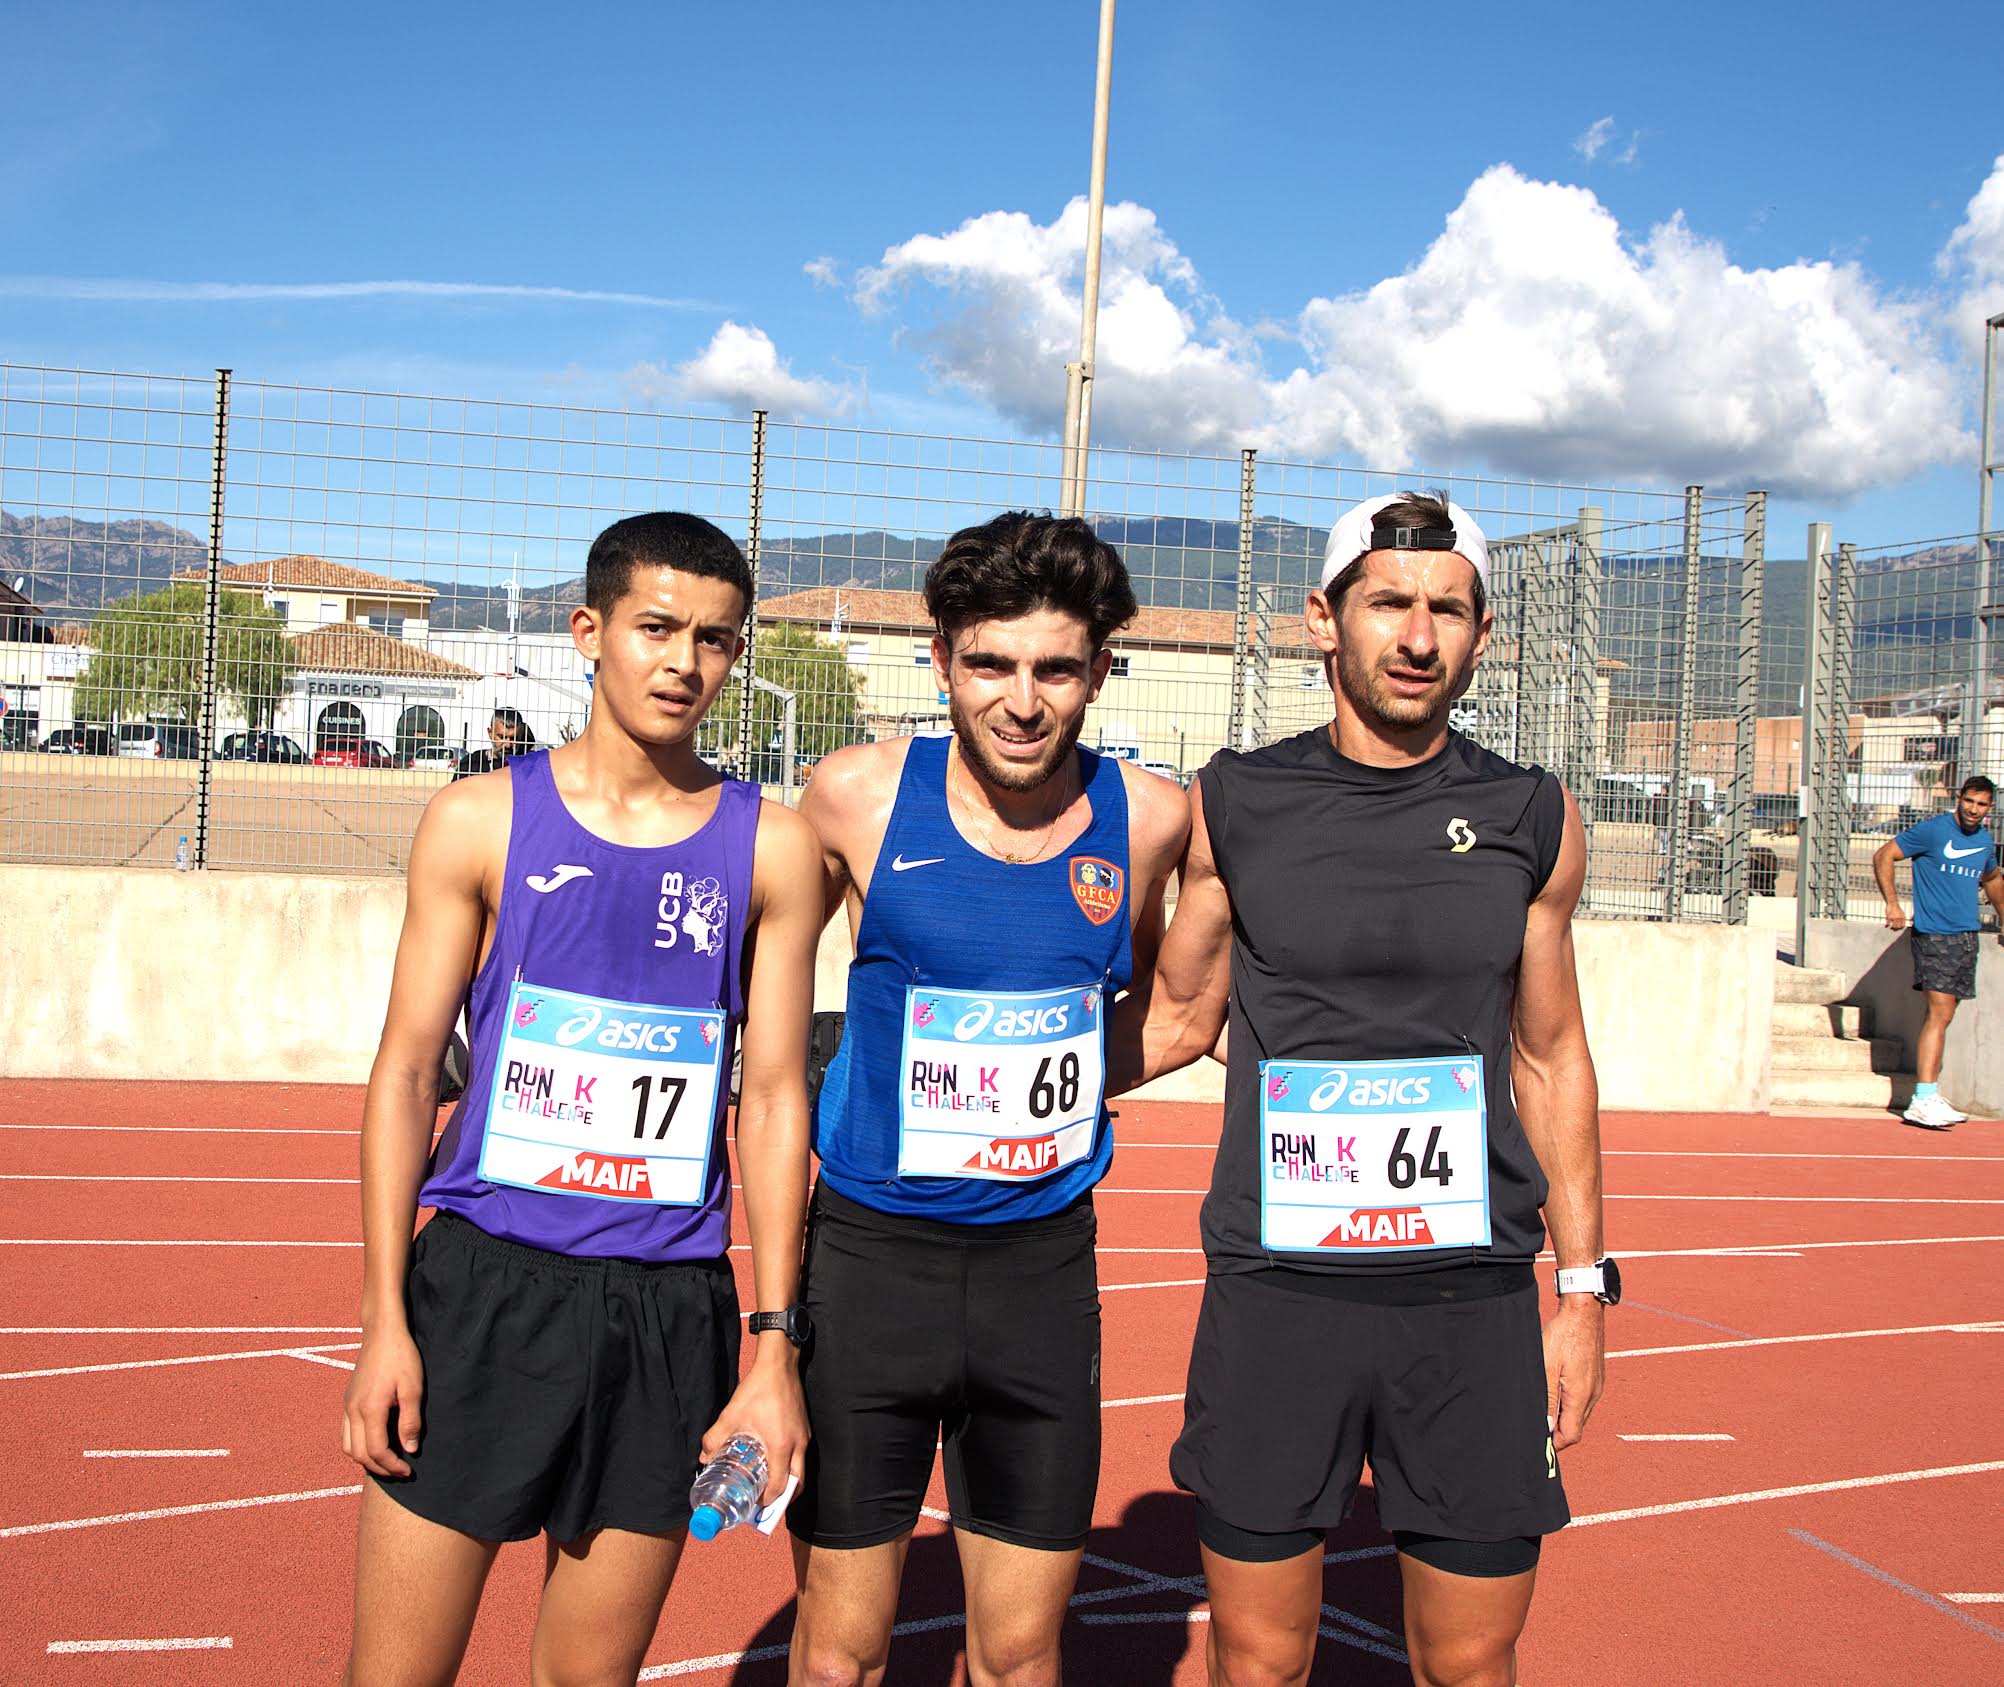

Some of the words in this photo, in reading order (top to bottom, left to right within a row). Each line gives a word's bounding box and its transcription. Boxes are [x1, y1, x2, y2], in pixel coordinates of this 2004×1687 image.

[322, 716, 362, 726] CUISINES
[654, 871, 684, 949] UCB
[1077, 884, 1116, 904] GFCA
[597, 1019, 682, 1053] asics
[993, 1004, 1070, 1037] asics
[504, 1060, 554, 1100] RUN
[574, 1075, 598, 1103] K
[911, 1060, 957, 1095] RUN
[980, 1067, 1000, 1092] K
[1029, 1051, 1080, 1119] 68
[1348, 1076, 1433, 1106] asics
[502, 1087, 593, 1125] CHALLENGE
[631, 1075, 688, 1140] 17
[911, 1085, 1000, 1113] CHALLENGE
[979, 1140, 1058, 1171] MAIF
[1271, 1133, 1316, 1166] RUN
[1337, 1136, 1356, 1162] K
[1387, 1125, 1454, 1189] 64
[560, 1158, 649, 1192] MAIF
[1272, 1156, 1359, 1183] CHALLENGE
[1340, 1213, 1426, 1242] MAIF
